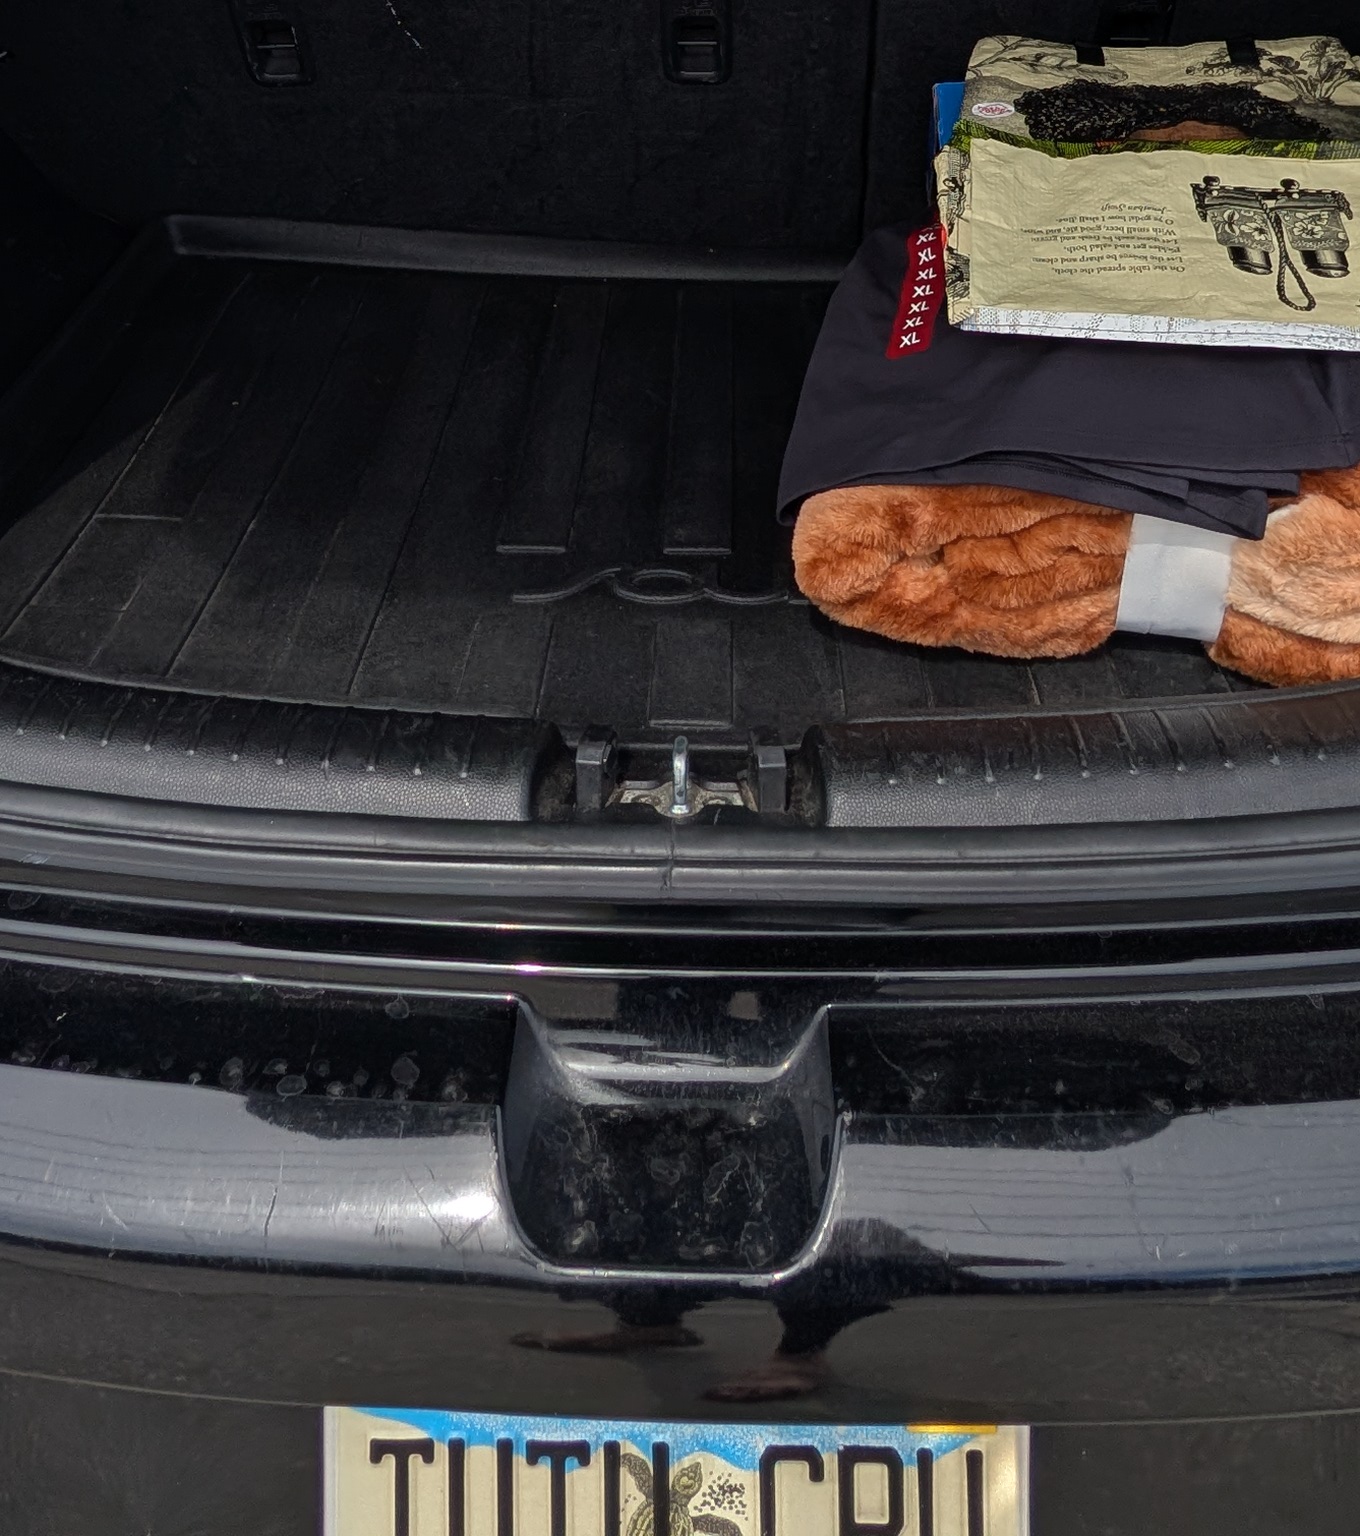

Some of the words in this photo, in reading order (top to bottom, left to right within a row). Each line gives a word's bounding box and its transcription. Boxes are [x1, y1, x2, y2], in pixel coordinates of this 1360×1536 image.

[1152, 228, 1176, 236] With
[916, 232, 937, 246] XL
[918, 247, 936, 266] XL
[916, 268, 937, 281] XL
[1096, 264, 1126, 274] spread
[1128, 265, 1150, 274] table
[912, 284, 934, 298] XL
[908, 301, 930, 314] XL
[902, 316, 924, 330] XL
[899, 332, 920, 348] XL
